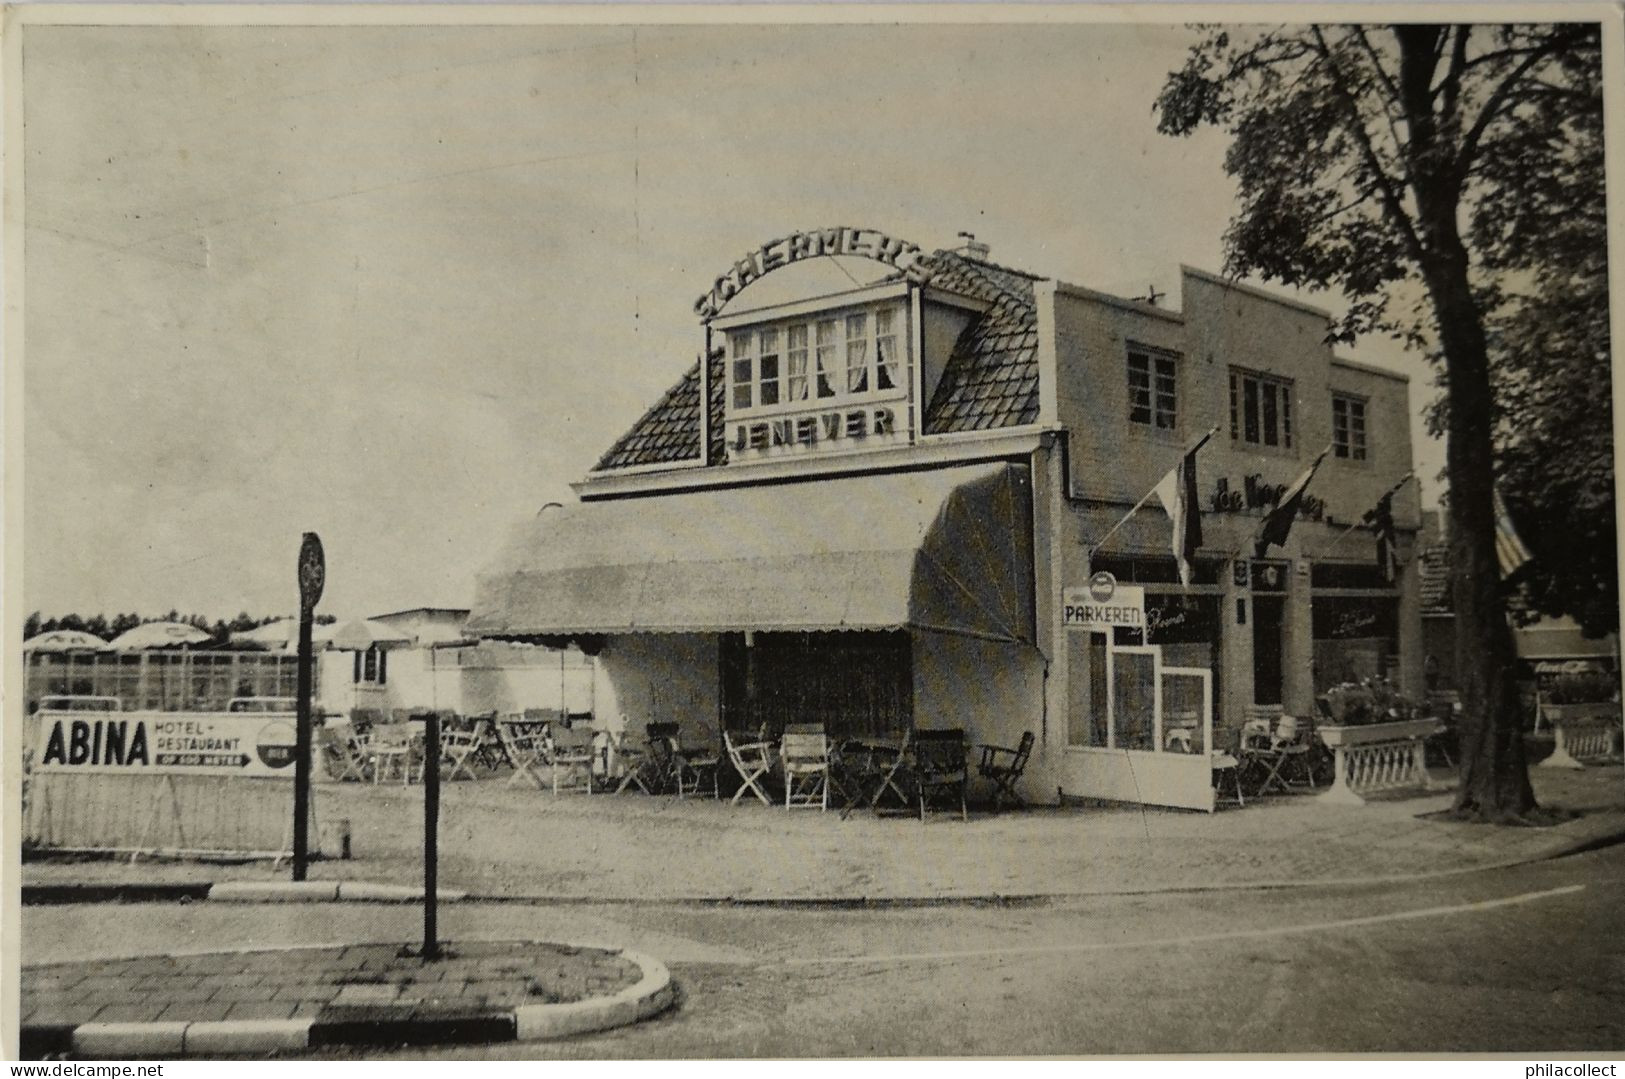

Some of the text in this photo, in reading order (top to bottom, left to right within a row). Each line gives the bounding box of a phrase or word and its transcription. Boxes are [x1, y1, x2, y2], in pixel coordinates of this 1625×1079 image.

[728, 408, 894, 451] JENEVER
[1065, 605, 1140, 623] PARKEREN
[43, 720, 149, 766] ABINA
[158, 738, 240, 751] RESTAURANT
